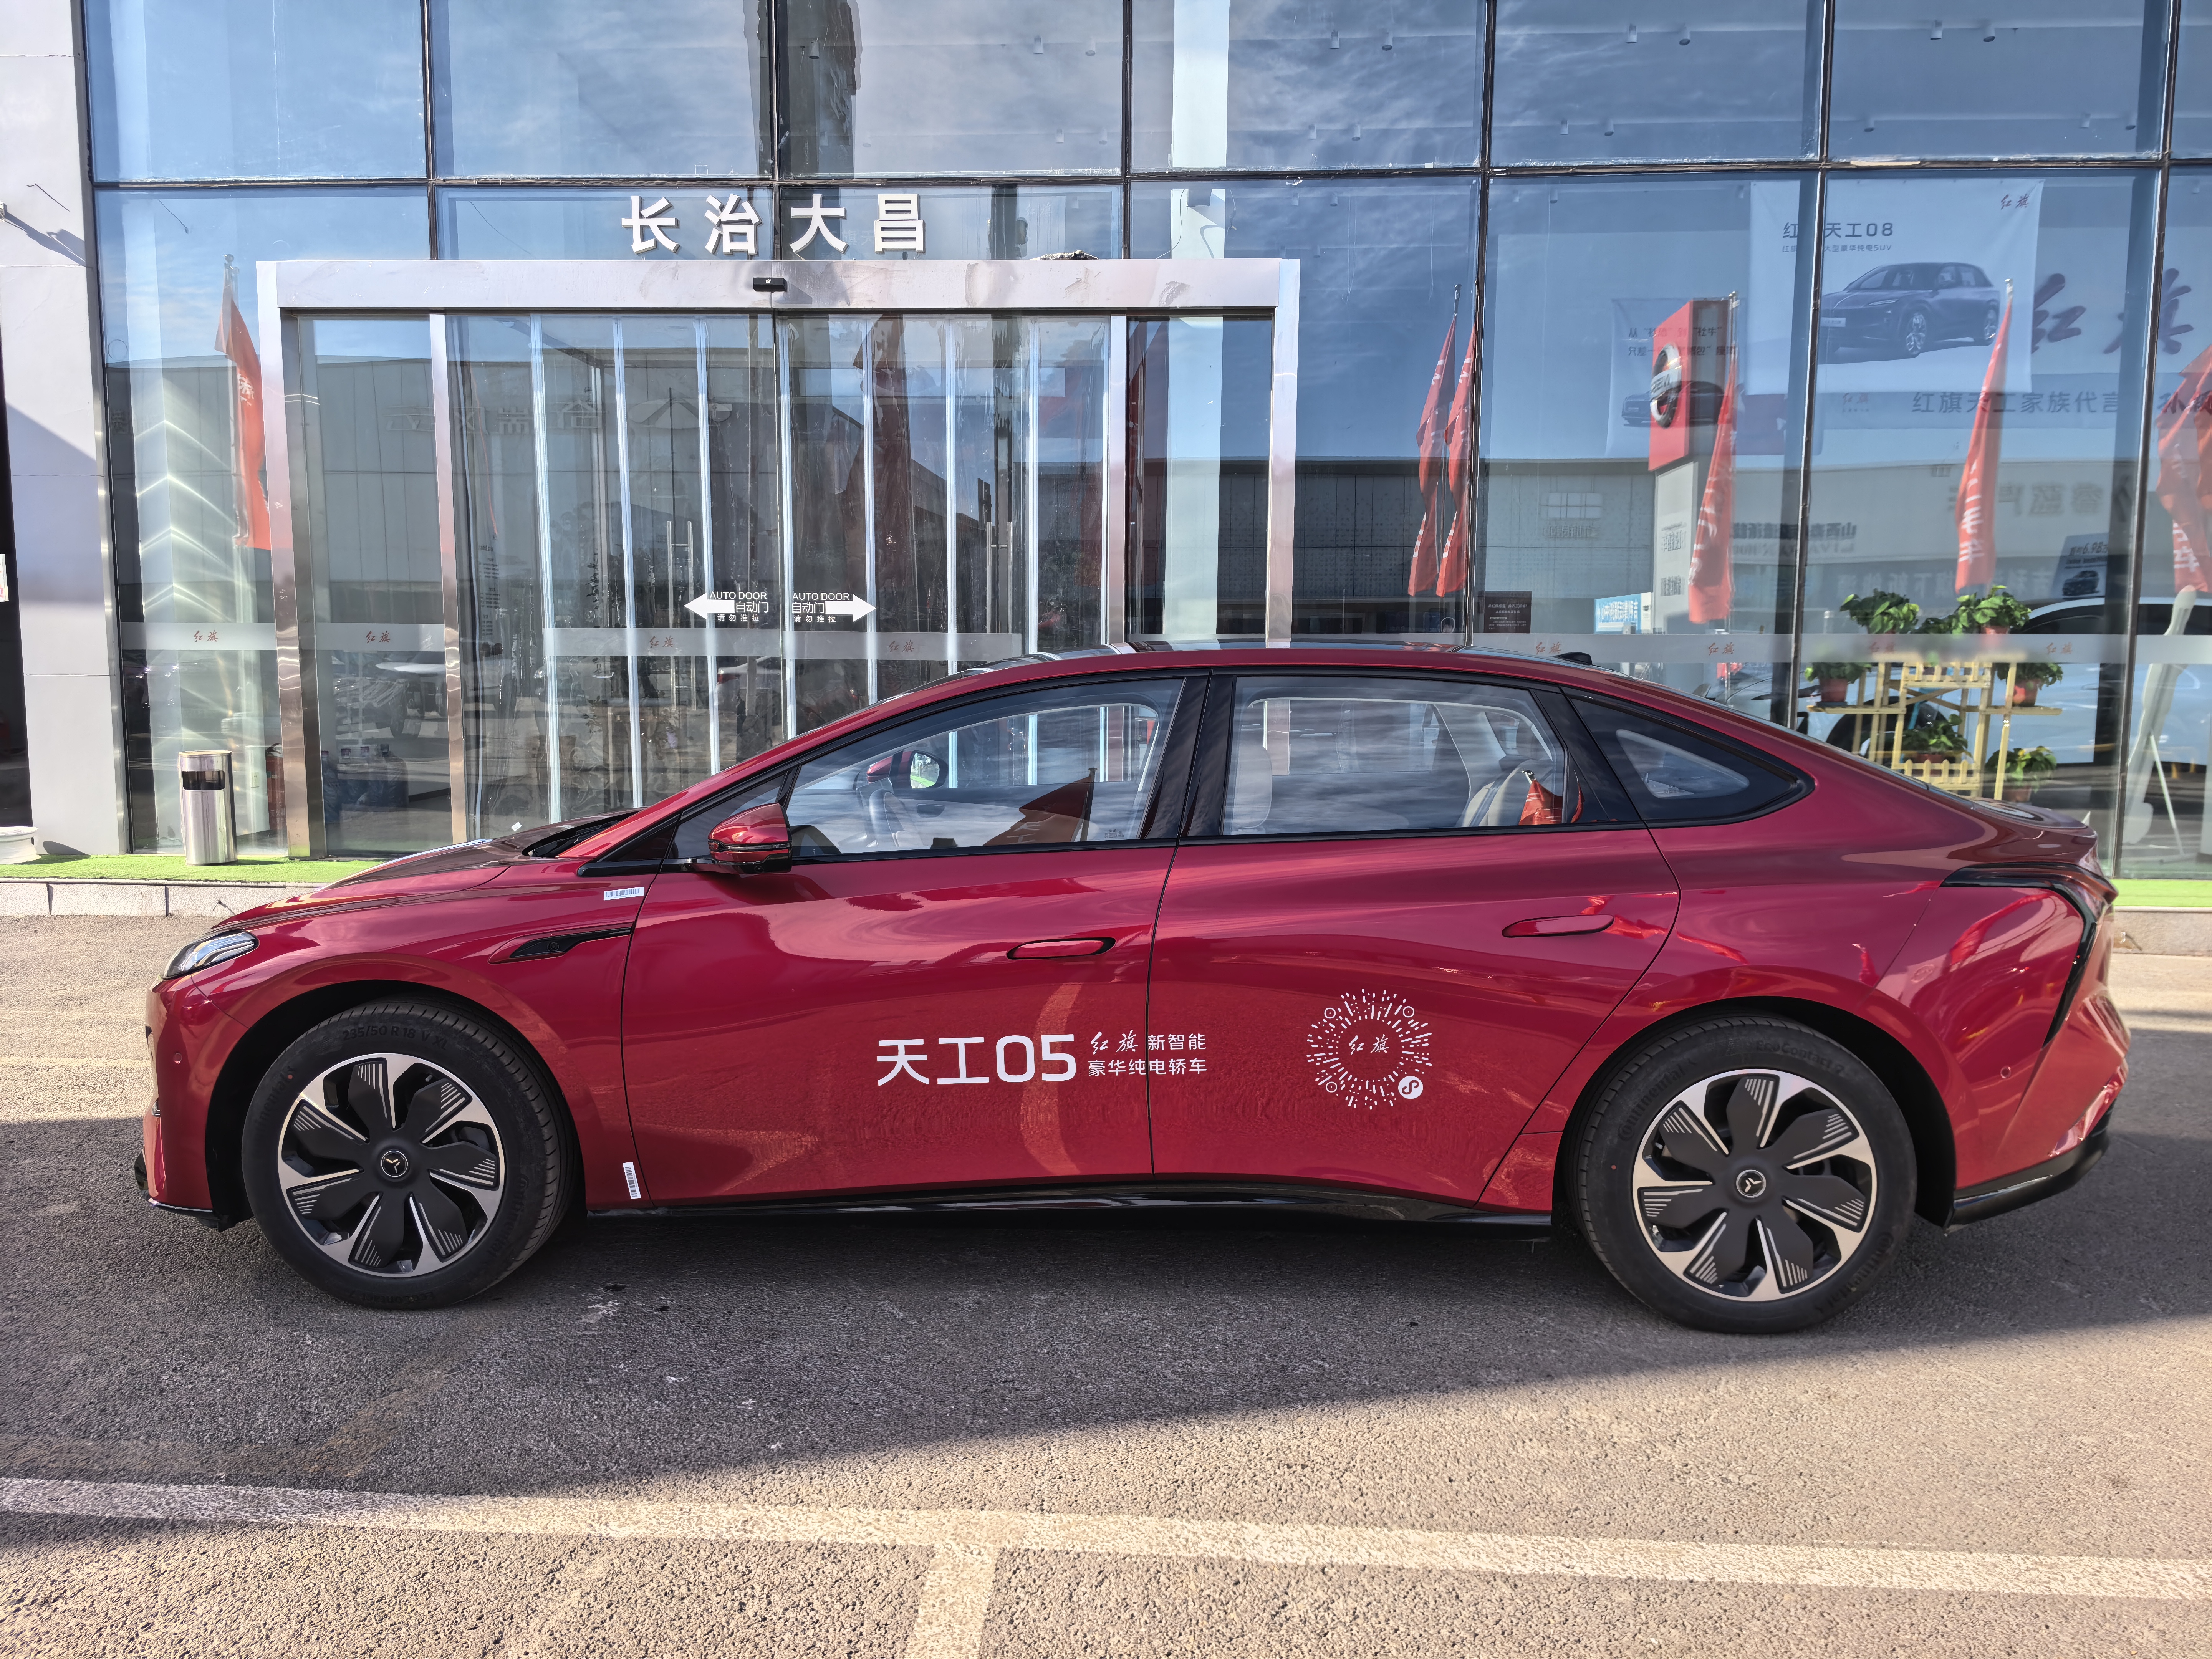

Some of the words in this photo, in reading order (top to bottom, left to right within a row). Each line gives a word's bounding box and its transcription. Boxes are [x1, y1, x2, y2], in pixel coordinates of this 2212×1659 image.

[2000, 194, 2030, 210] 红旗
[621, 193, 926, 256] 长治大昌
[709, 591, 736, 600] AUTO
[738, 591, 768, 600] DOOR
[792, 593, 819, 601] AUTO
[821, 593, 850, 601] DOOR
[735, 601, 768, 613] 自动门
[792, 602, 825, 614] 自动门
[717, 614, 760, 622] 请勿推拉
[794, 615, 836, 623] 请勿推拉
[194, 630, 219, 643] 红旗
[366, 630, 391, 644] 红旗
[649, 636, 675, 649] 红旗
[889, 640, 915, 653] 红旗
[342, 1025, 387, 1041] 235/50
[391, 1026, 400, 1036] R
[403, 1027, 416, 1038] 18
[422, 1031, 430, 1042] V
[432, 1035, 448, 1050] XL
[1091, 1030, 1138, 1055] 红旗
[1147, 1033, 1206, 1051] 新智能
[1349, 1034, 1390, 1055] 红旗
[877, 1034, 1076, 1086] 天工05
[1088, 1058, 1207, 1076] 豪华纯电轿车
[1618, 1063, 1685, 1141] Continental
